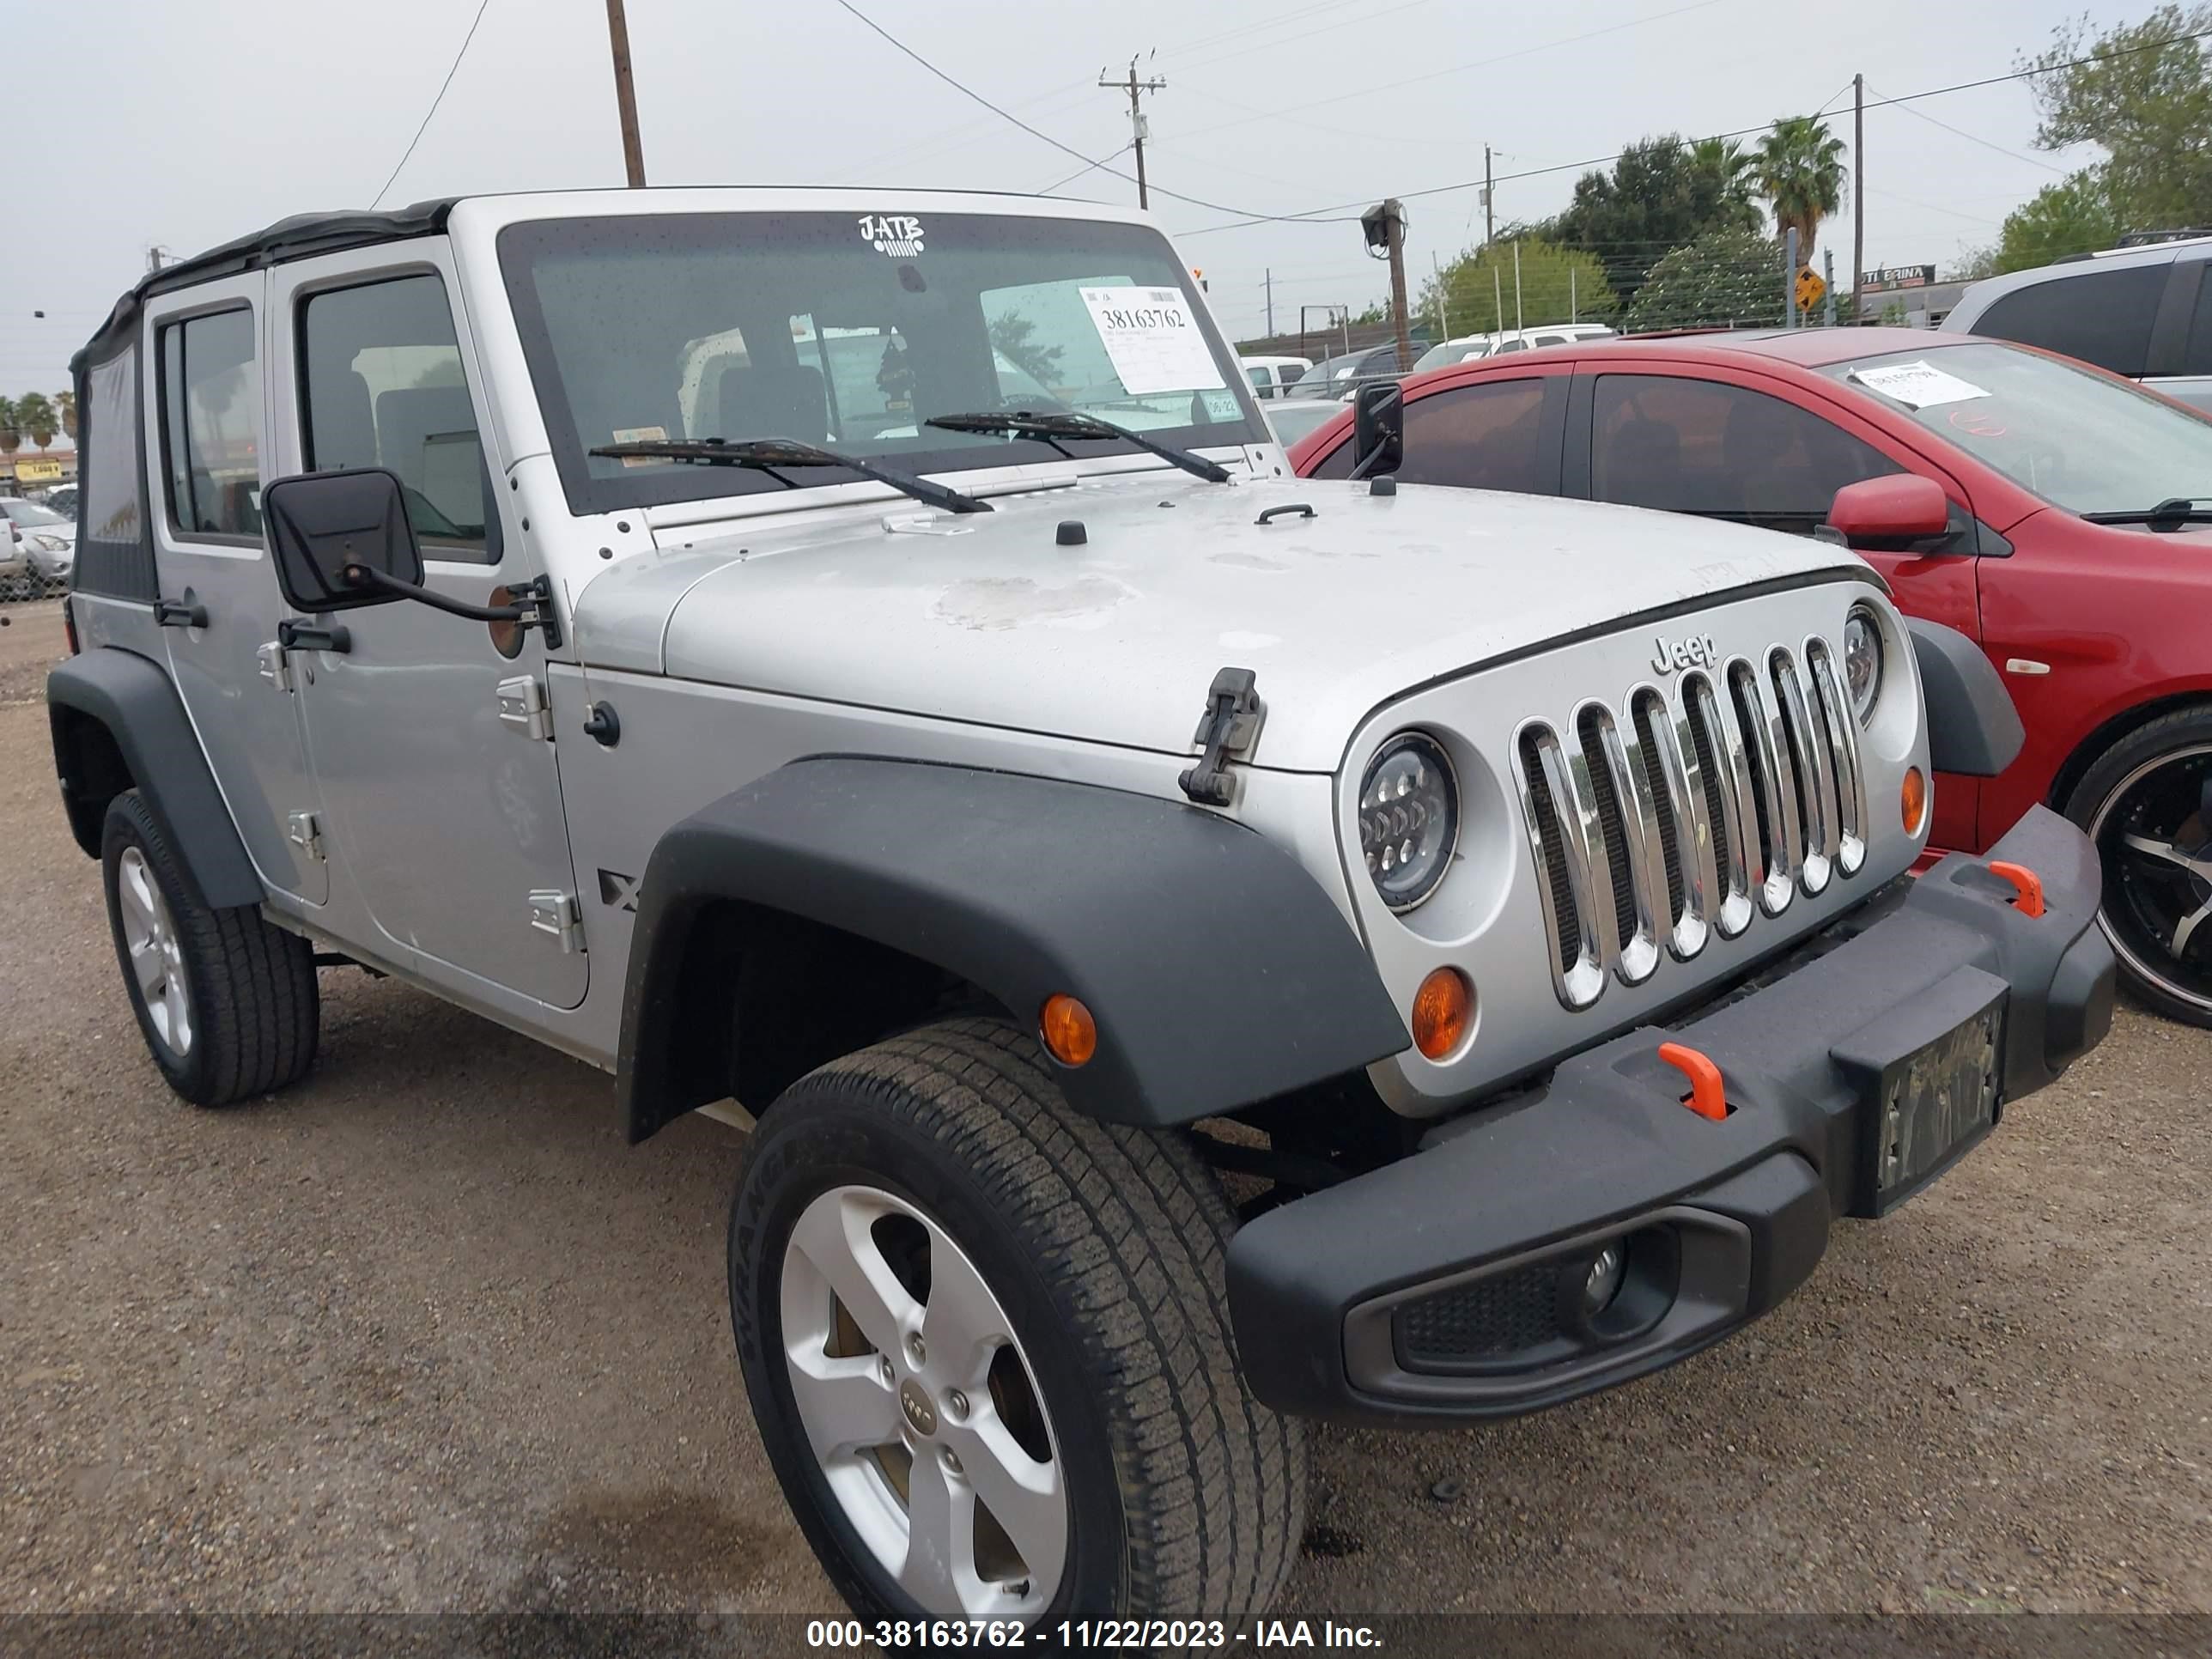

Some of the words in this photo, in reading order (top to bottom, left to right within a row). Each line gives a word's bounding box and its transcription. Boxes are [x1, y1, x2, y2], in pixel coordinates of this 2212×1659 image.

[859, 215, 925, 240] JATB
[1102, 309, 1185, 330] 38163762
[1650, 633, 1717, 676] Jeep
